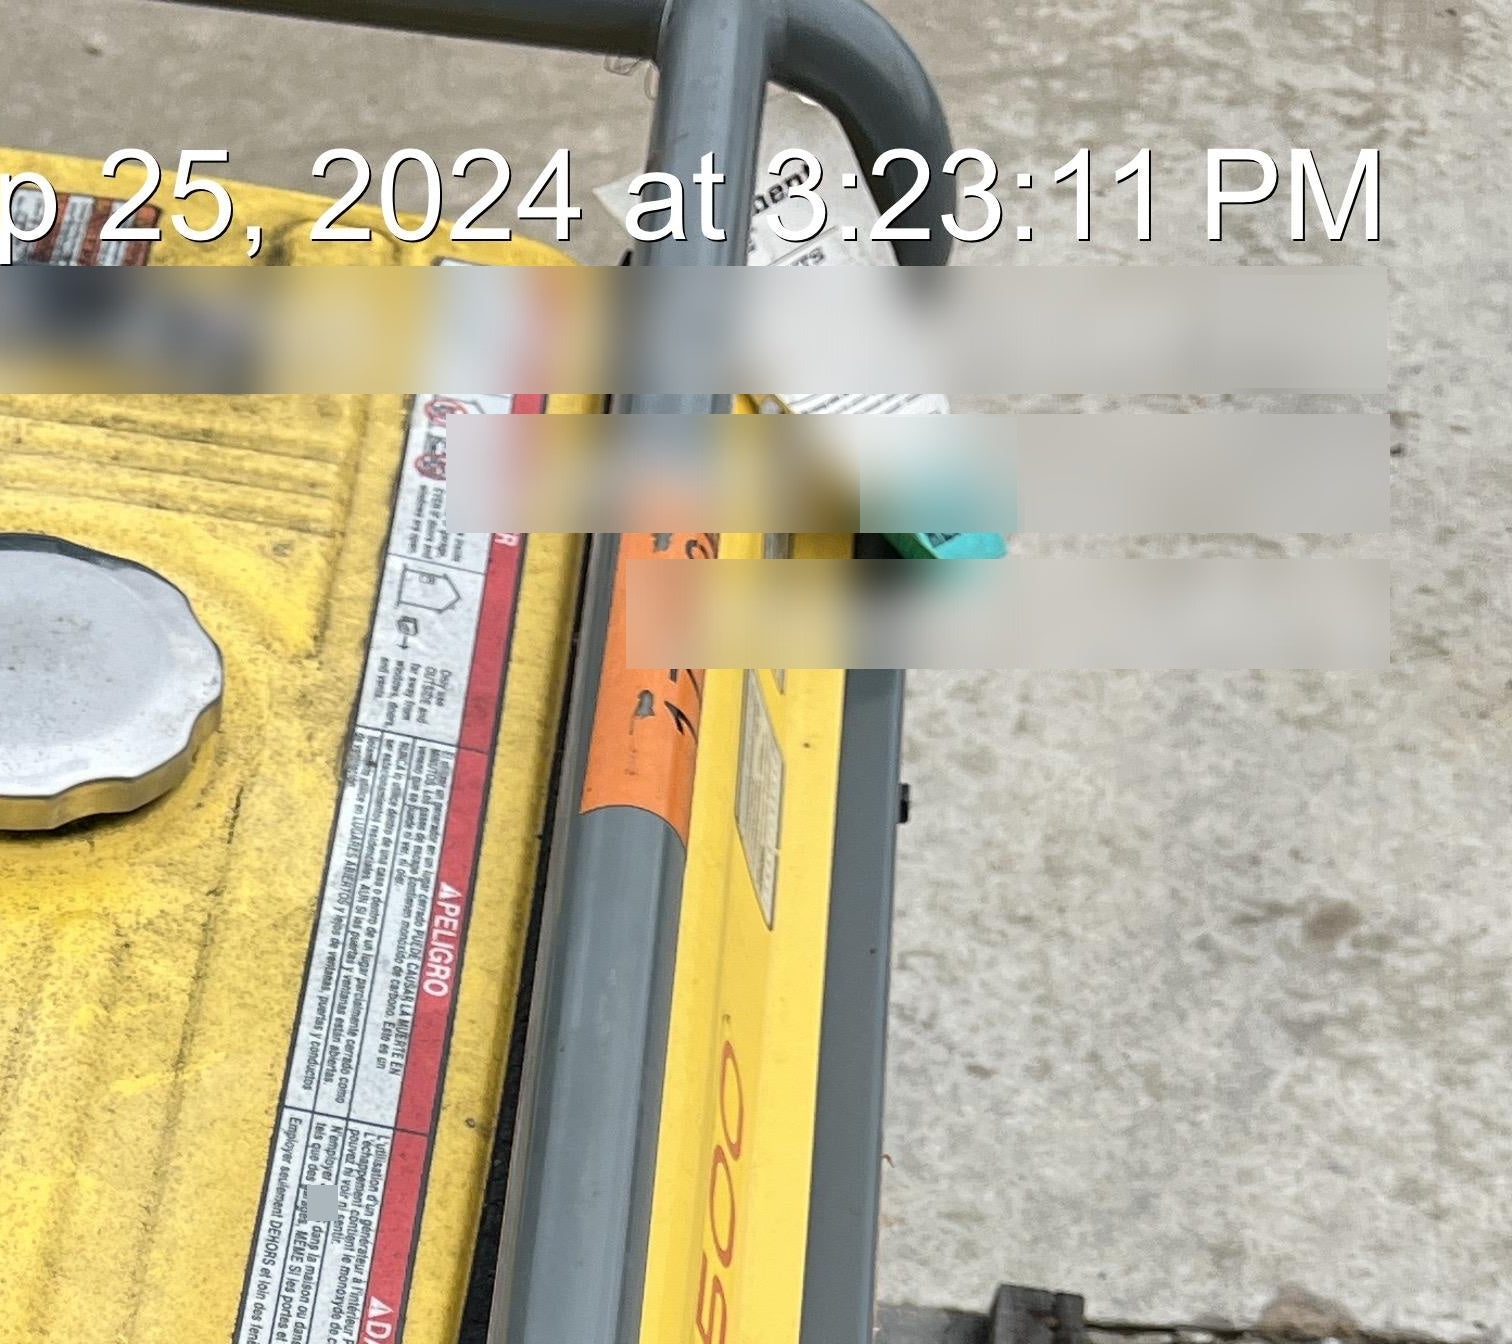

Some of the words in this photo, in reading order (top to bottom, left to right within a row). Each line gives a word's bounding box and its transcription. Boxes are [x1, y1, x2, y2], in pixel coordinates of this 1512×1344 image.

[329, 936, 341, 949] de
[408, 928, 425, 960] PUEDE
[423, 901, 460, 996] PELIGRO
[341, 964, 353, 973] y
[402, 961, 419, 1002] CAUSAR
[336, 974, 351, 1015] ventanas
[312, 994, 329, 1030] puertas
[399, 1002, 412, 1017] LA
[310, 1032, 322, 1040] y
[393, 1018, 409, 1059] MUERTE
[303, 1040, 321, 1091] conductos
[390, 1060, 404, 1076] EN
[281, 1116, 303, 1164] Employer
[312, 1121, 327, 1140] tels
[308, 1141, 322, 1162] que
[320, 1124, 343, 1181] N'employer
[344, 1127, 359, 1165] pouvez
[305, 1162, 319, 1182] des
[342, 1166, 356, 1178] ni
[368, 1134, 389, 1192] L'utilisation
[271, 1165, 290, 1218] seulement
[338, 1178, 351, 1200] voir
[363, 1193, 379, 1217] d'un
[307, 1224, 324, 1251] dans
[343, 1208, 361, 1252] contient
[262, 1219, 283, 1266] DEHORS
[305, 1252, 320, 1263] la
[340, 1252, 355, 1264] le
[259, 1266, 272, 1279] et
[287, 1263, 302, 1276] SI
[255, 1279, 271, 1300] loin
[284, 1277, 299, 1293] les
[299, 1264, 315, 1303] maison
[330, 1264, 350, 1320] monoxyde
[250, 1301, 266, 1322] des
[276, 1294, 293, 1329] portes
[295, 1304, 308, 1319] ou
[275, 1330, 288, 1343] et
[328, 1321, 342, 1336] de
